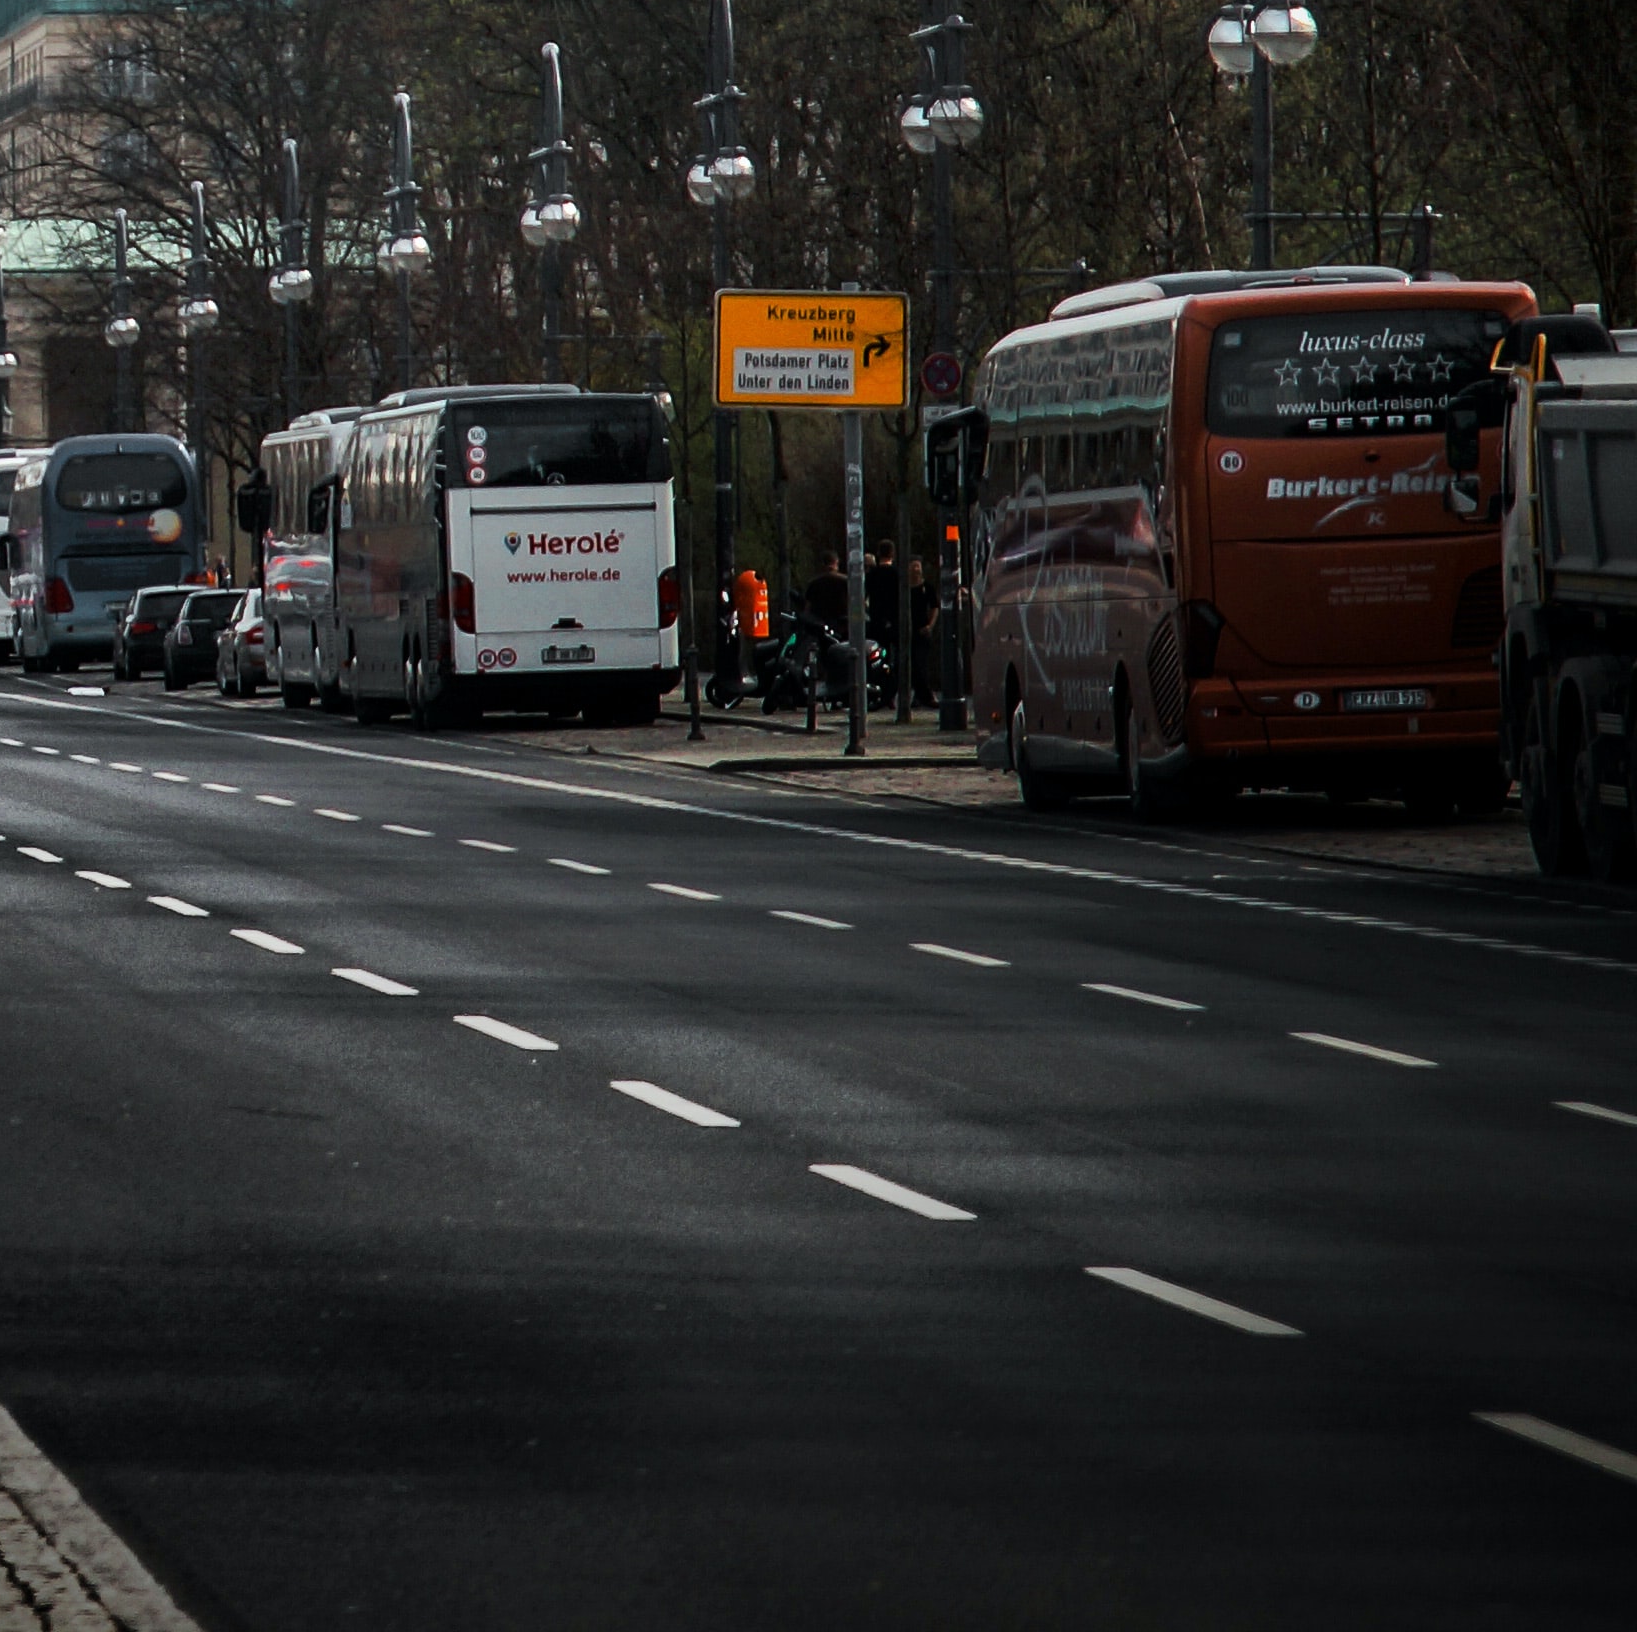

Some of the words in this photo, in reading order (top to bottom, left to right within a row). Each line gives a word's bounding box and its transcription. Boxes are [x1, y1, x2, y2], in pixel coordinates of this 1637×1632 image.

[768, 305, 855, 324] Kreuzberg
[813, 327, 854, 342] Mitte
[1299, 328, 1426, 353] luxus-class
[745, 352, 812, 369] Potsdamer
[818, 353, 849, 369] Platz
[738, 373, 771, 389] Unter
[779, 374, 802, 389] den
[808, 374, 849, 389] Linden
[1227, 390, 1248, 407] 100
[1308, 414, 1433, 430] SETRA
[528, 529, 620, 555] Herolé
[507, 567, 621, 583] www.herole.de
